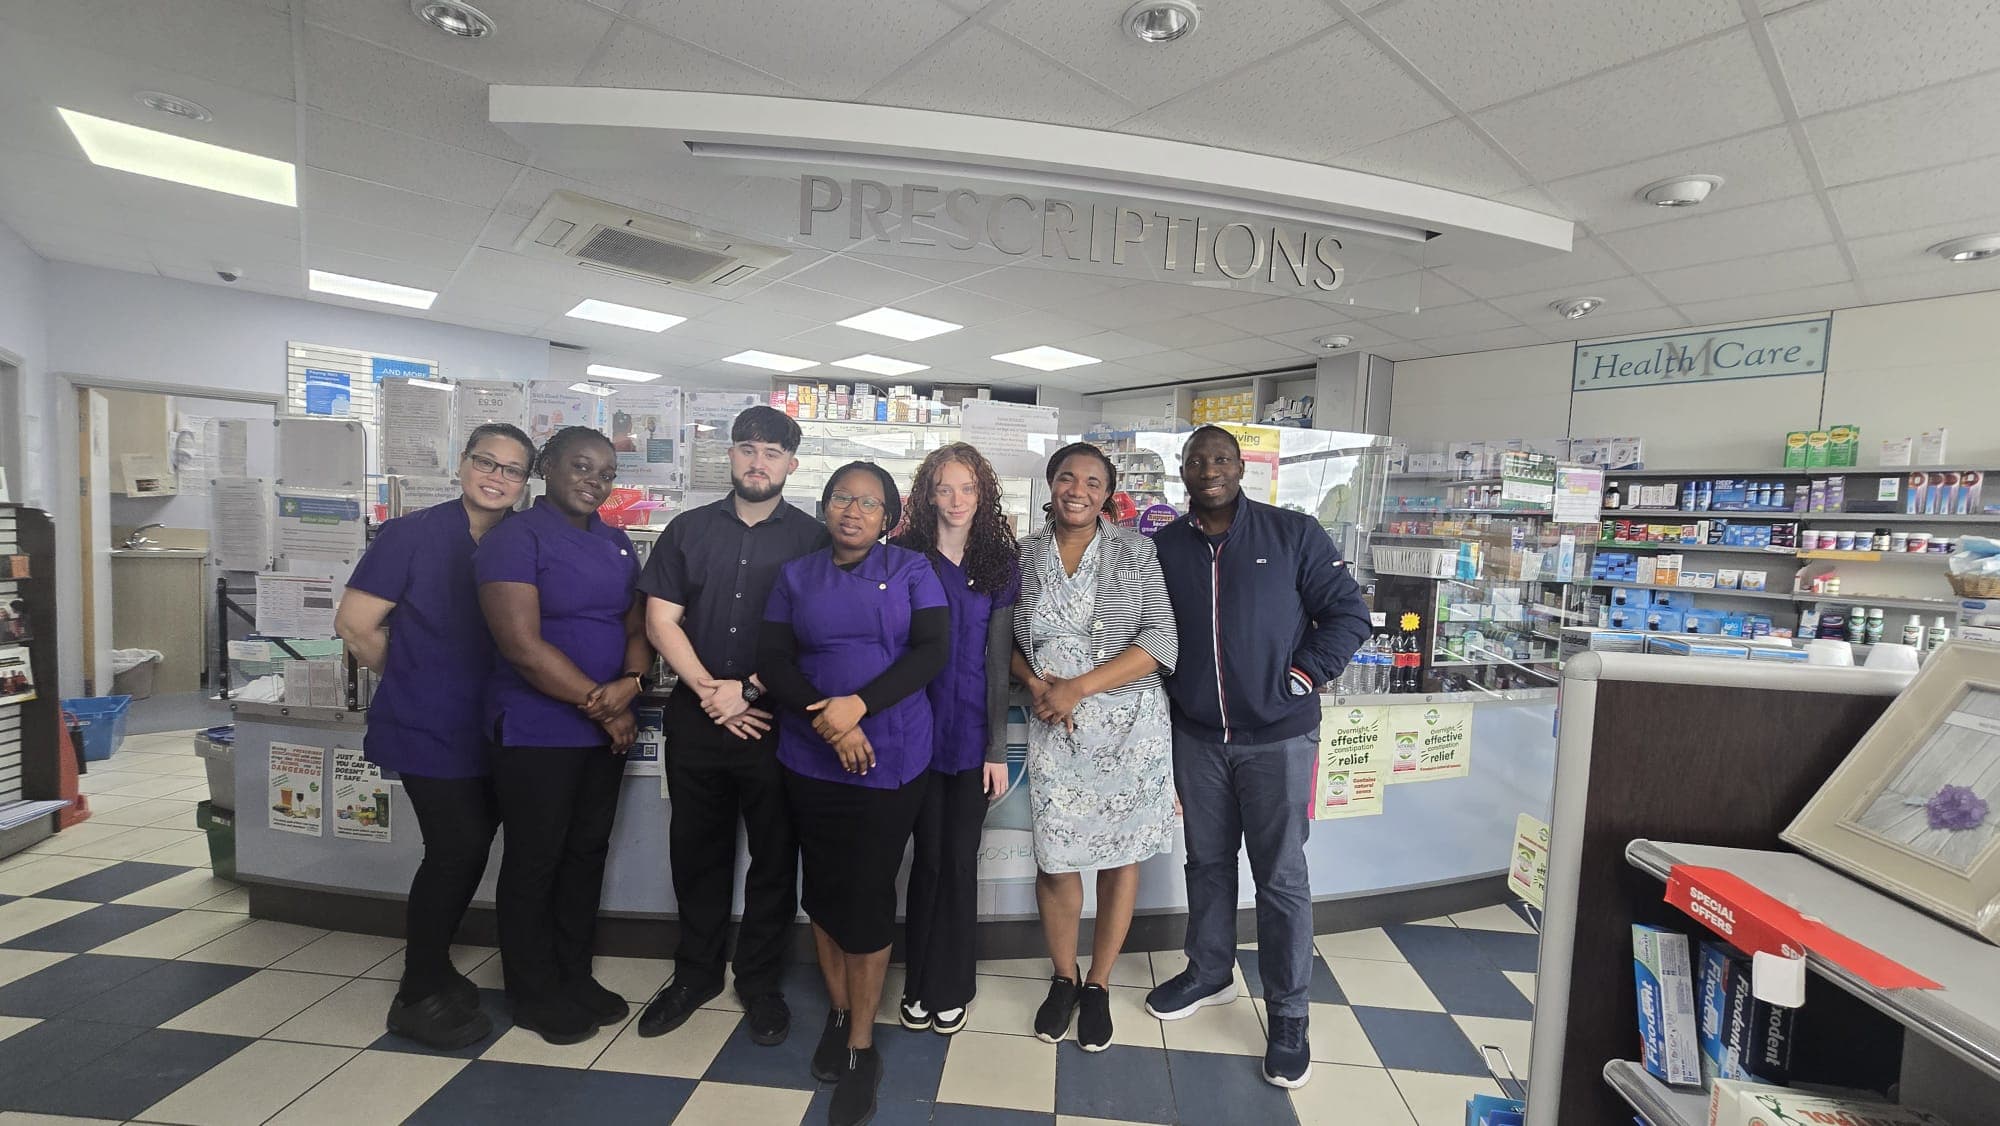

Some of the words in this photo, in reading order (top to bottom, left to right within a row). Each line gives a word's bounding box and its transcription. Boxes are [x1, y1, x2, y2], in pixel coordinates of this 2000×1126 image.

[799, 173, 1347, 292] PRESCRIPTIONS
[1592, 346, 1695, 380] Health
[1713, 342, 1802, 369] Care
[382, 368, 401, 376] AND
[1331, 733, 1378, 747] effective
[1424, 732, 1463, 746] effective
[1334, 743, 1374, 754] constipation
[1427, 742, 1459, 752] constipation
[335, 753, 354, 761] JUST
[1338, 753, 1369, 766] relief
[1430, 750, 1455, 764] relief
[271, 764, 321, 777] DANGEROUS
[1690, 886, 1737, 924] SPECIAL
[1690, 901, 1733, 935] OFFERS
[1729, 973, 1750, 1056] Fixodent
